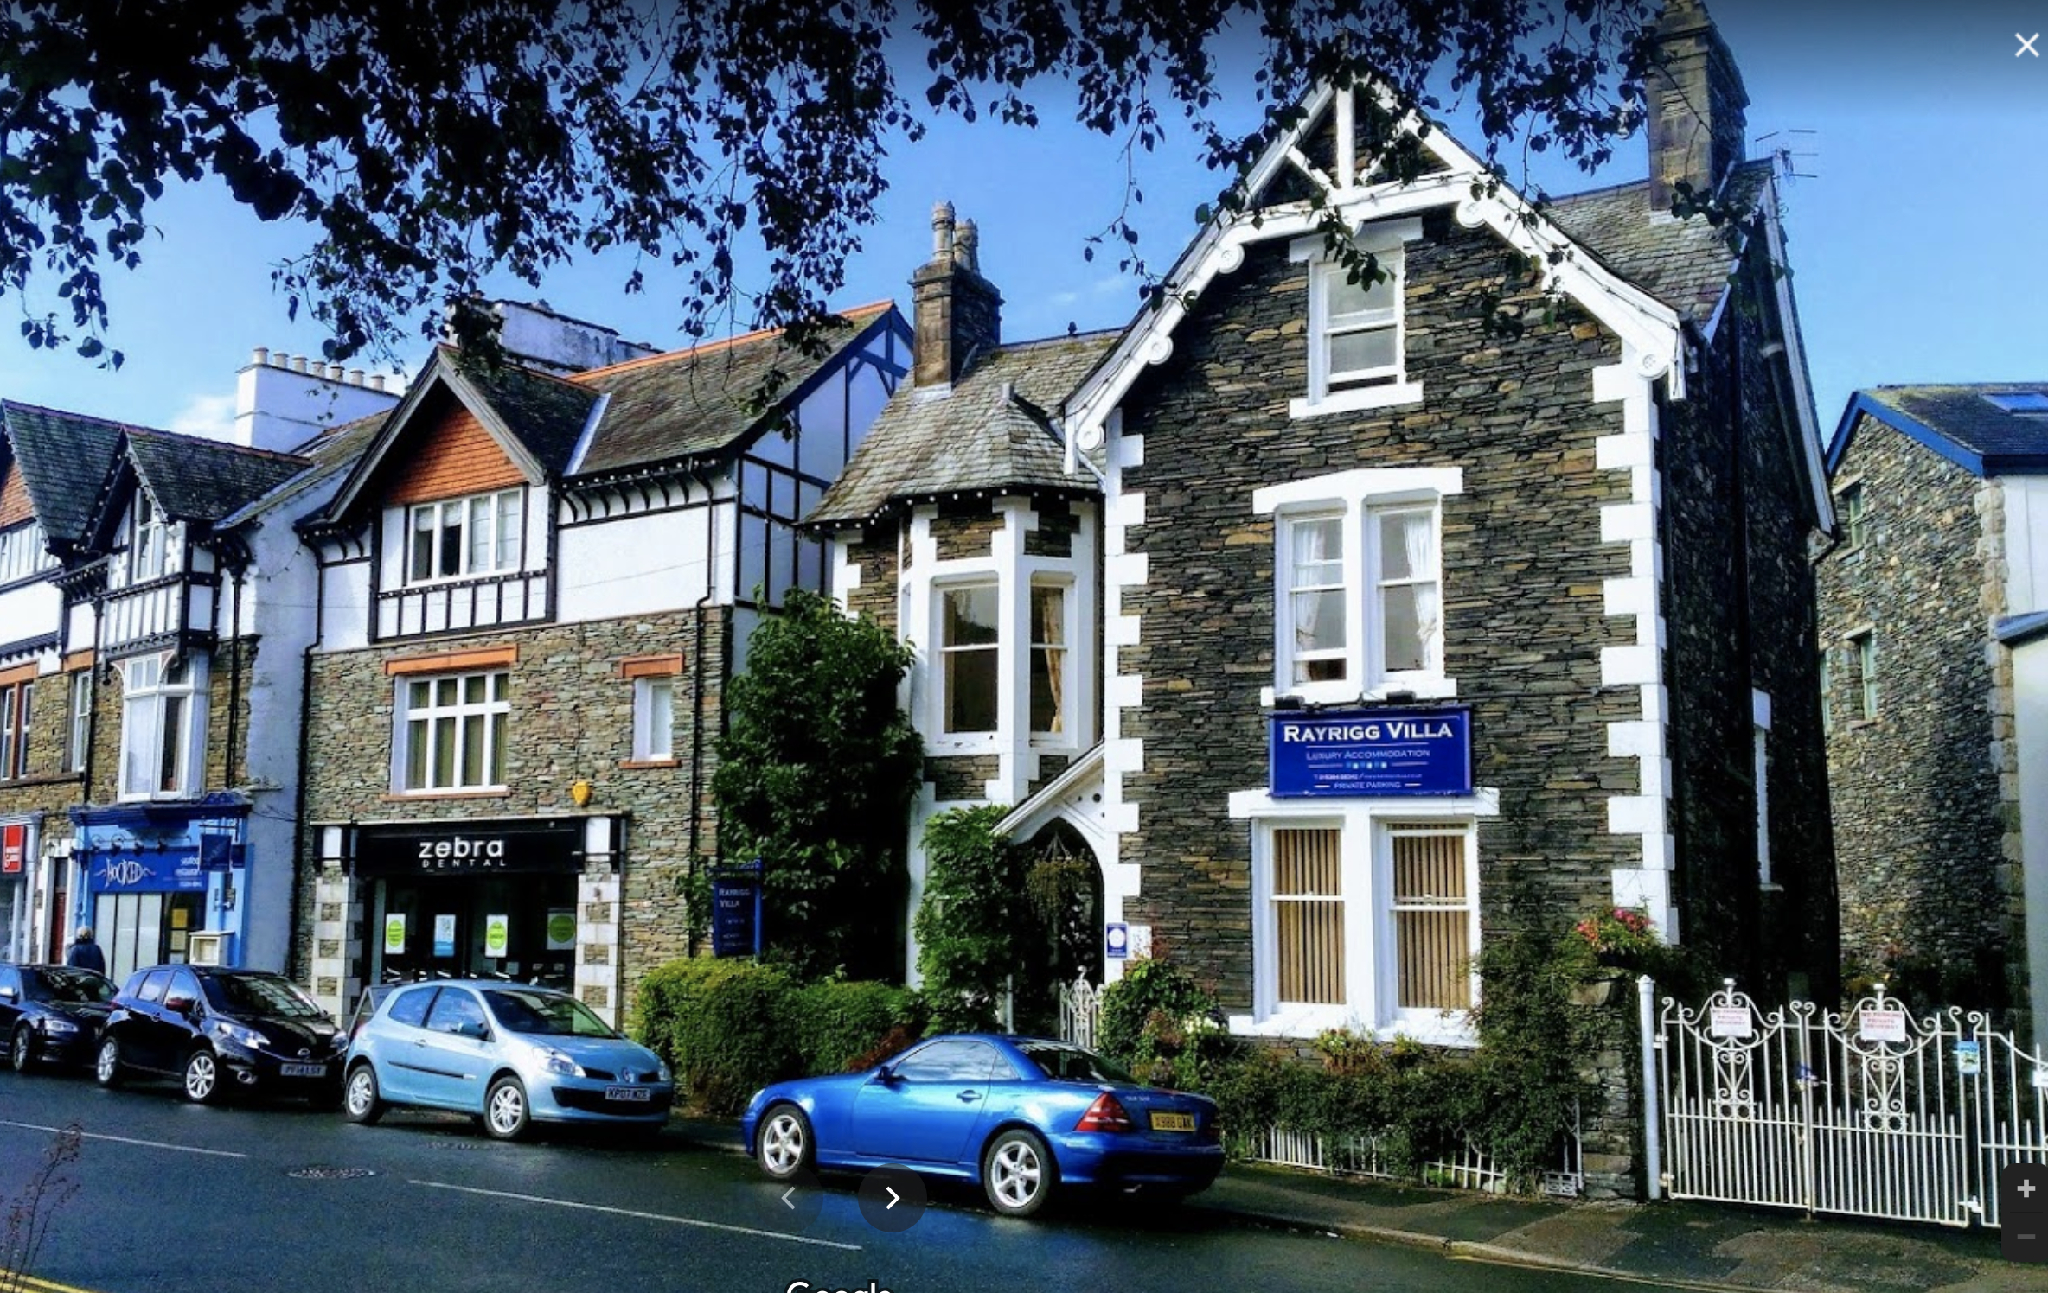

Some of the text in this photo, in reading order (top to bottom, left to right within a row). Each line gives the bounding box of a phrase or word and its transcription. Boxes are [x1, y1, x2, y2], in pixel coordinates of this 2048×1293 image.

[1283, 722, 1453, 742] RAYRIGG VILLA
[1306, 751, 1342, 761] LUXURY
[419, 836, 504, 858] zebra
[422, 859, 506, 868] DENTAL
